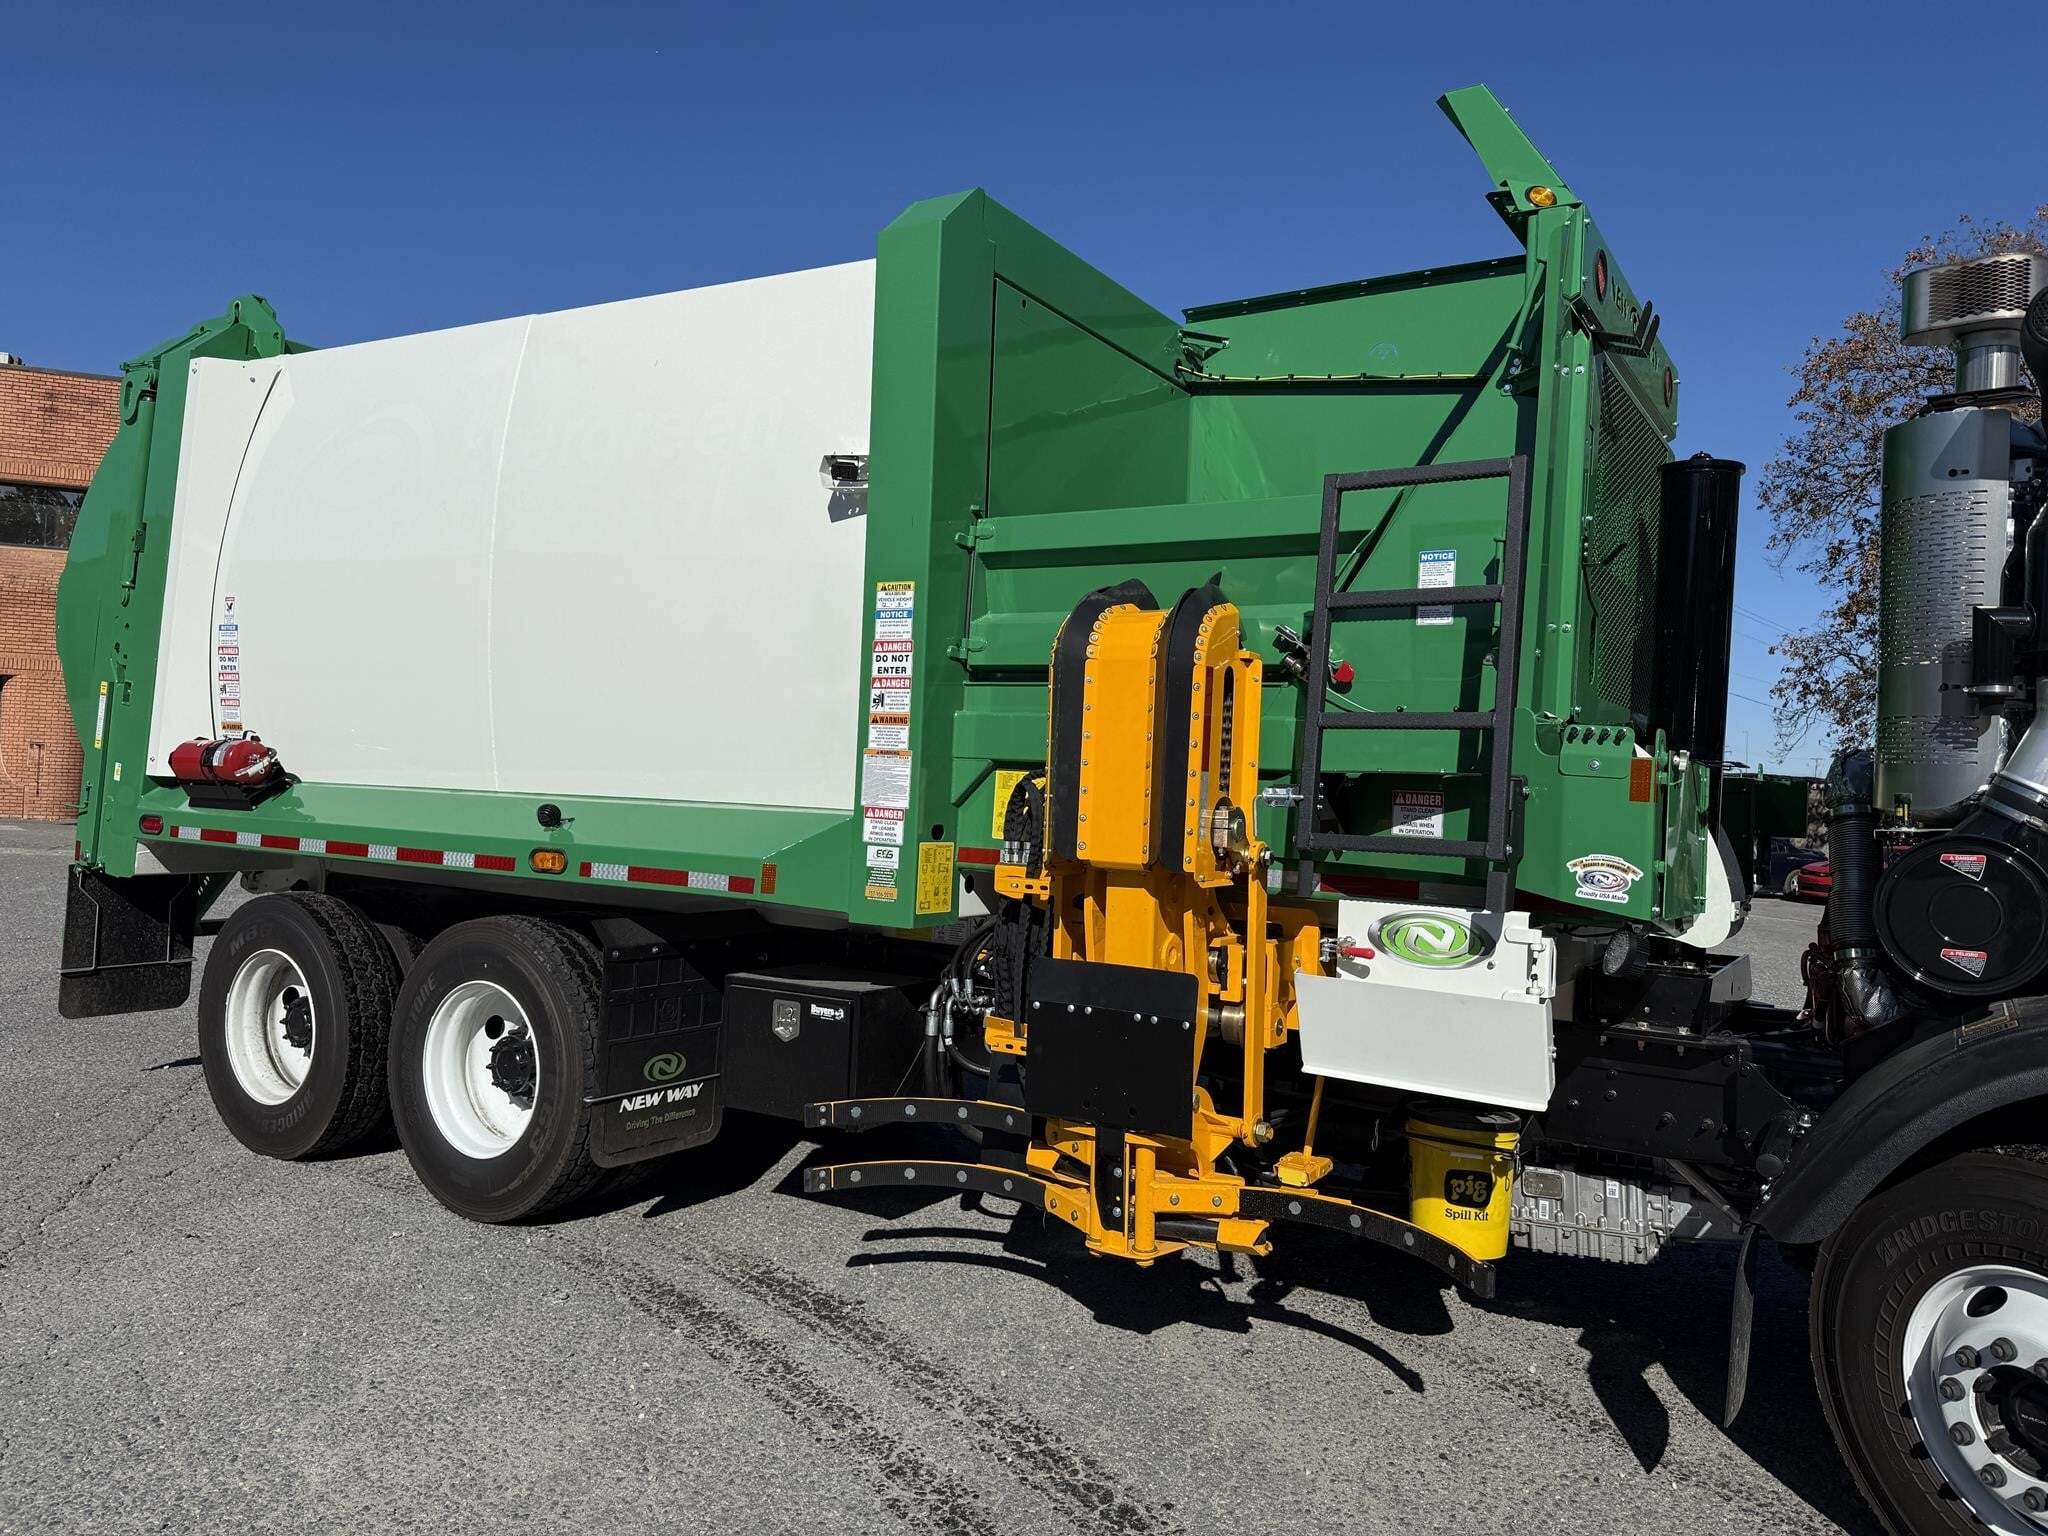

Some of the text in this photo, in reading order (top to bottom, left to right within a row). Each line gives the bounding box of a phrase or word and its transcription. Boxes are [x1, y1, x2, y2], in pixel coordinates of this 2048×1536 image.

[1421, 552, 1454, 561] NOTICE
[886, 583, 912, 591] CAUTION
[882, 641, 912, 651] DANGER
[875, 654, 910, 663] DO NOT
[877, 666, 907, 674] ENTER
[881, 678, 911, 688] DANGER
[879, 715, 908, 725] WARNING
[1405, 793, 1442, 806] DANGER
[874, 808, 903, 820] DANGER
[1577, 890, 1598, 898] Proudly
[619, 1082, 704, 1114] NEW WAY
[626, 1108, 697, 1132] Driving The Difference
[1450, 1175, 1488, 1203] pig
[1444, 1208, 1489, 1222] Spill Kit
